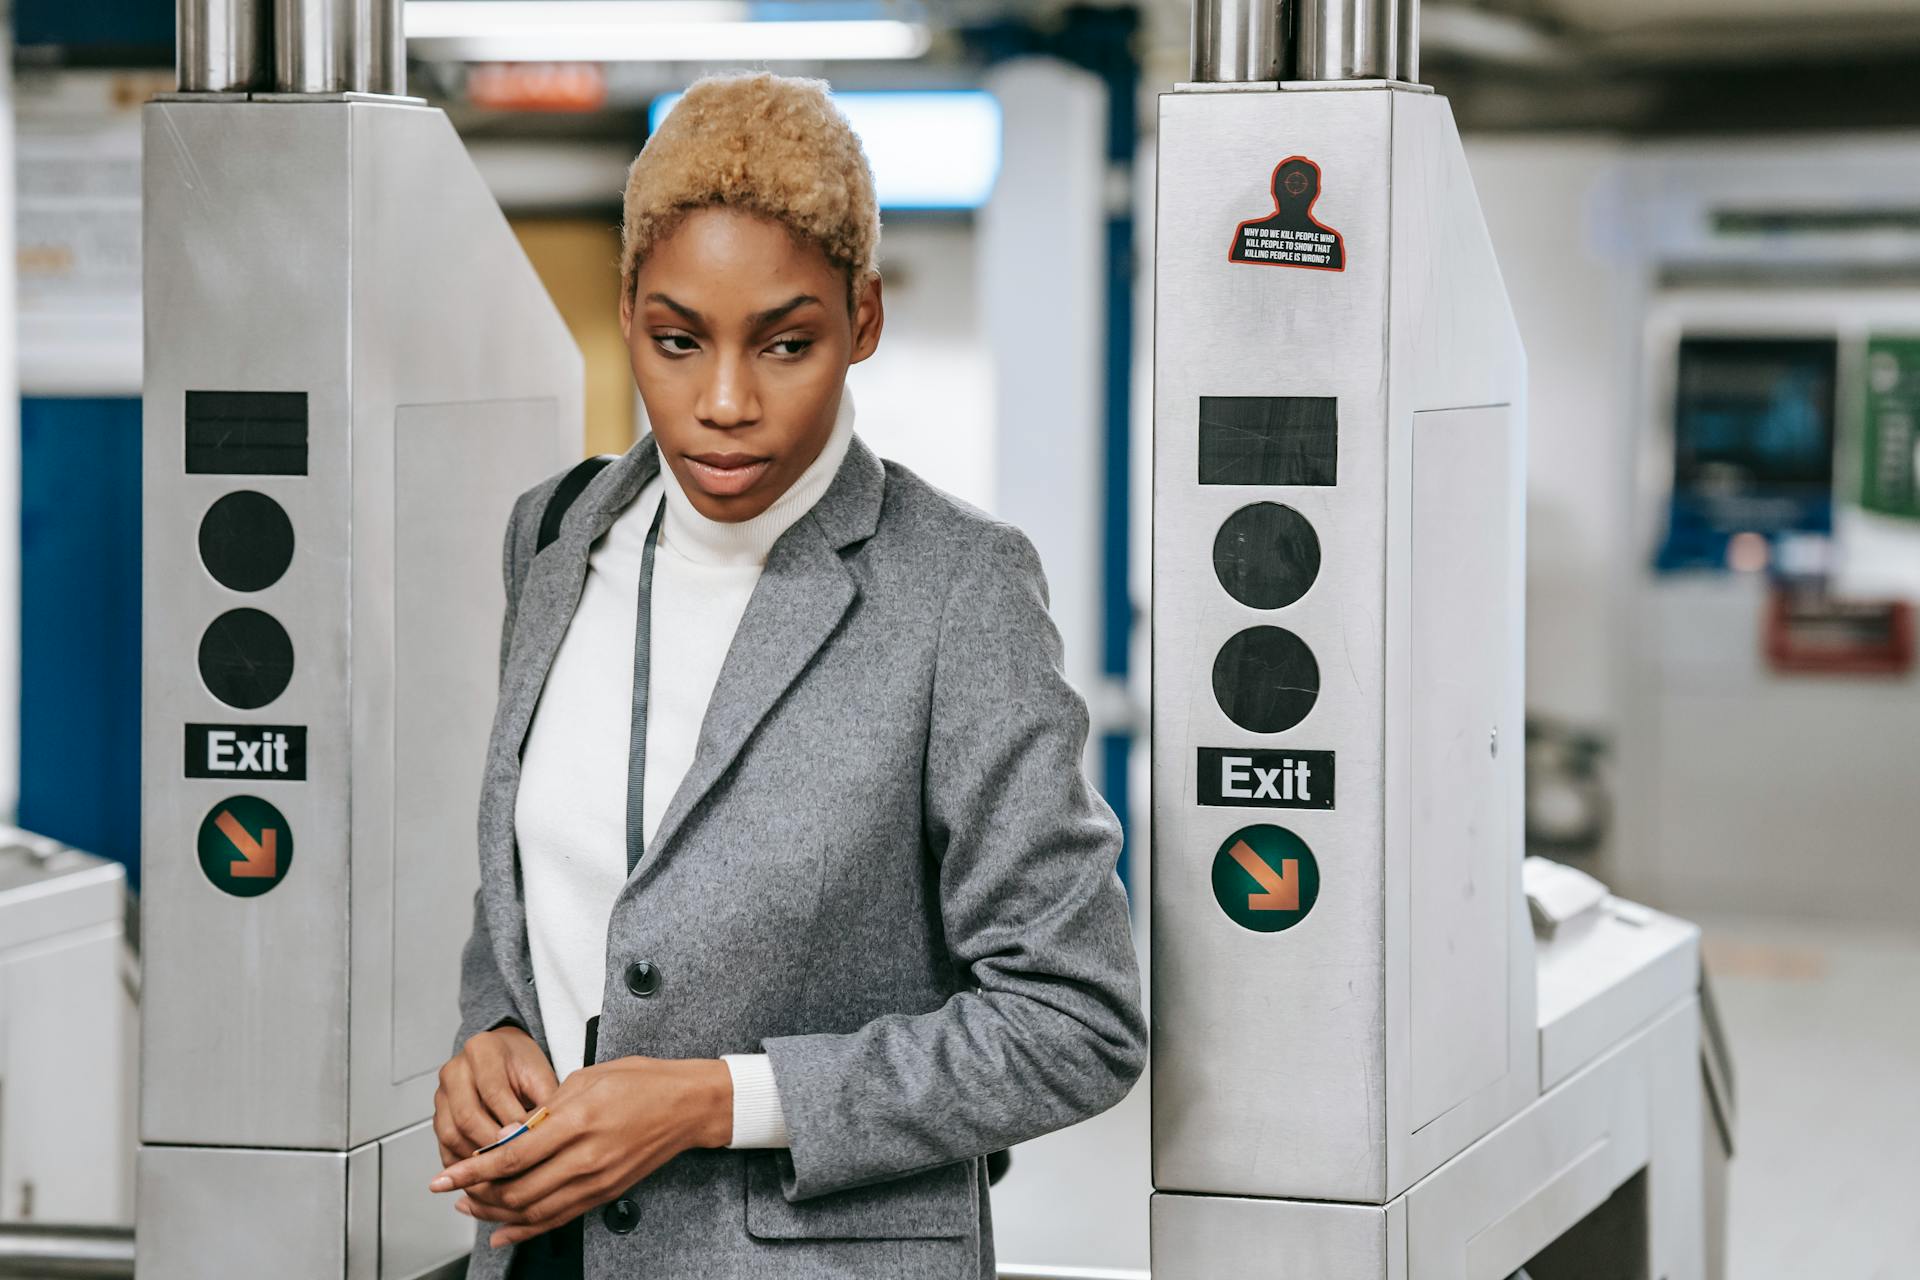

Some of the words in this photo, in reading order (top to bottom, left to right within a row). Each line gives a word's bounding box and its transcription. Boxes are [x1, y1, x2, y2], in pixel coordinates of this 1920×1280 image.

[1244, 228, 1259, 236] WHY
[1260, 228, 1268, 237] DO
[1270, 230, 1279, 238] WE
[1281, 230, 1294, 240] KILL
[1296, 232, 1319, 242] PEOPLE
[1320, 234, 1335, 243] WHO
[1246, 239, 1259, 248] KILL
[1261, 240, 1284, 249] PEOPLE
[1285, 241, 1293, 250] TO
[1294, 242, 1314, 252] SHOW
[1314, 244, 1331, 253] THAT
[1245, 249, 1268, 258] KILLING
[1270, 251, 1292, 261] PEOPLE
[1294, 253, 1300, 261] IS
[207, 731, 289, 773] Exit
[1221, 756, 1311, 801] Exit
